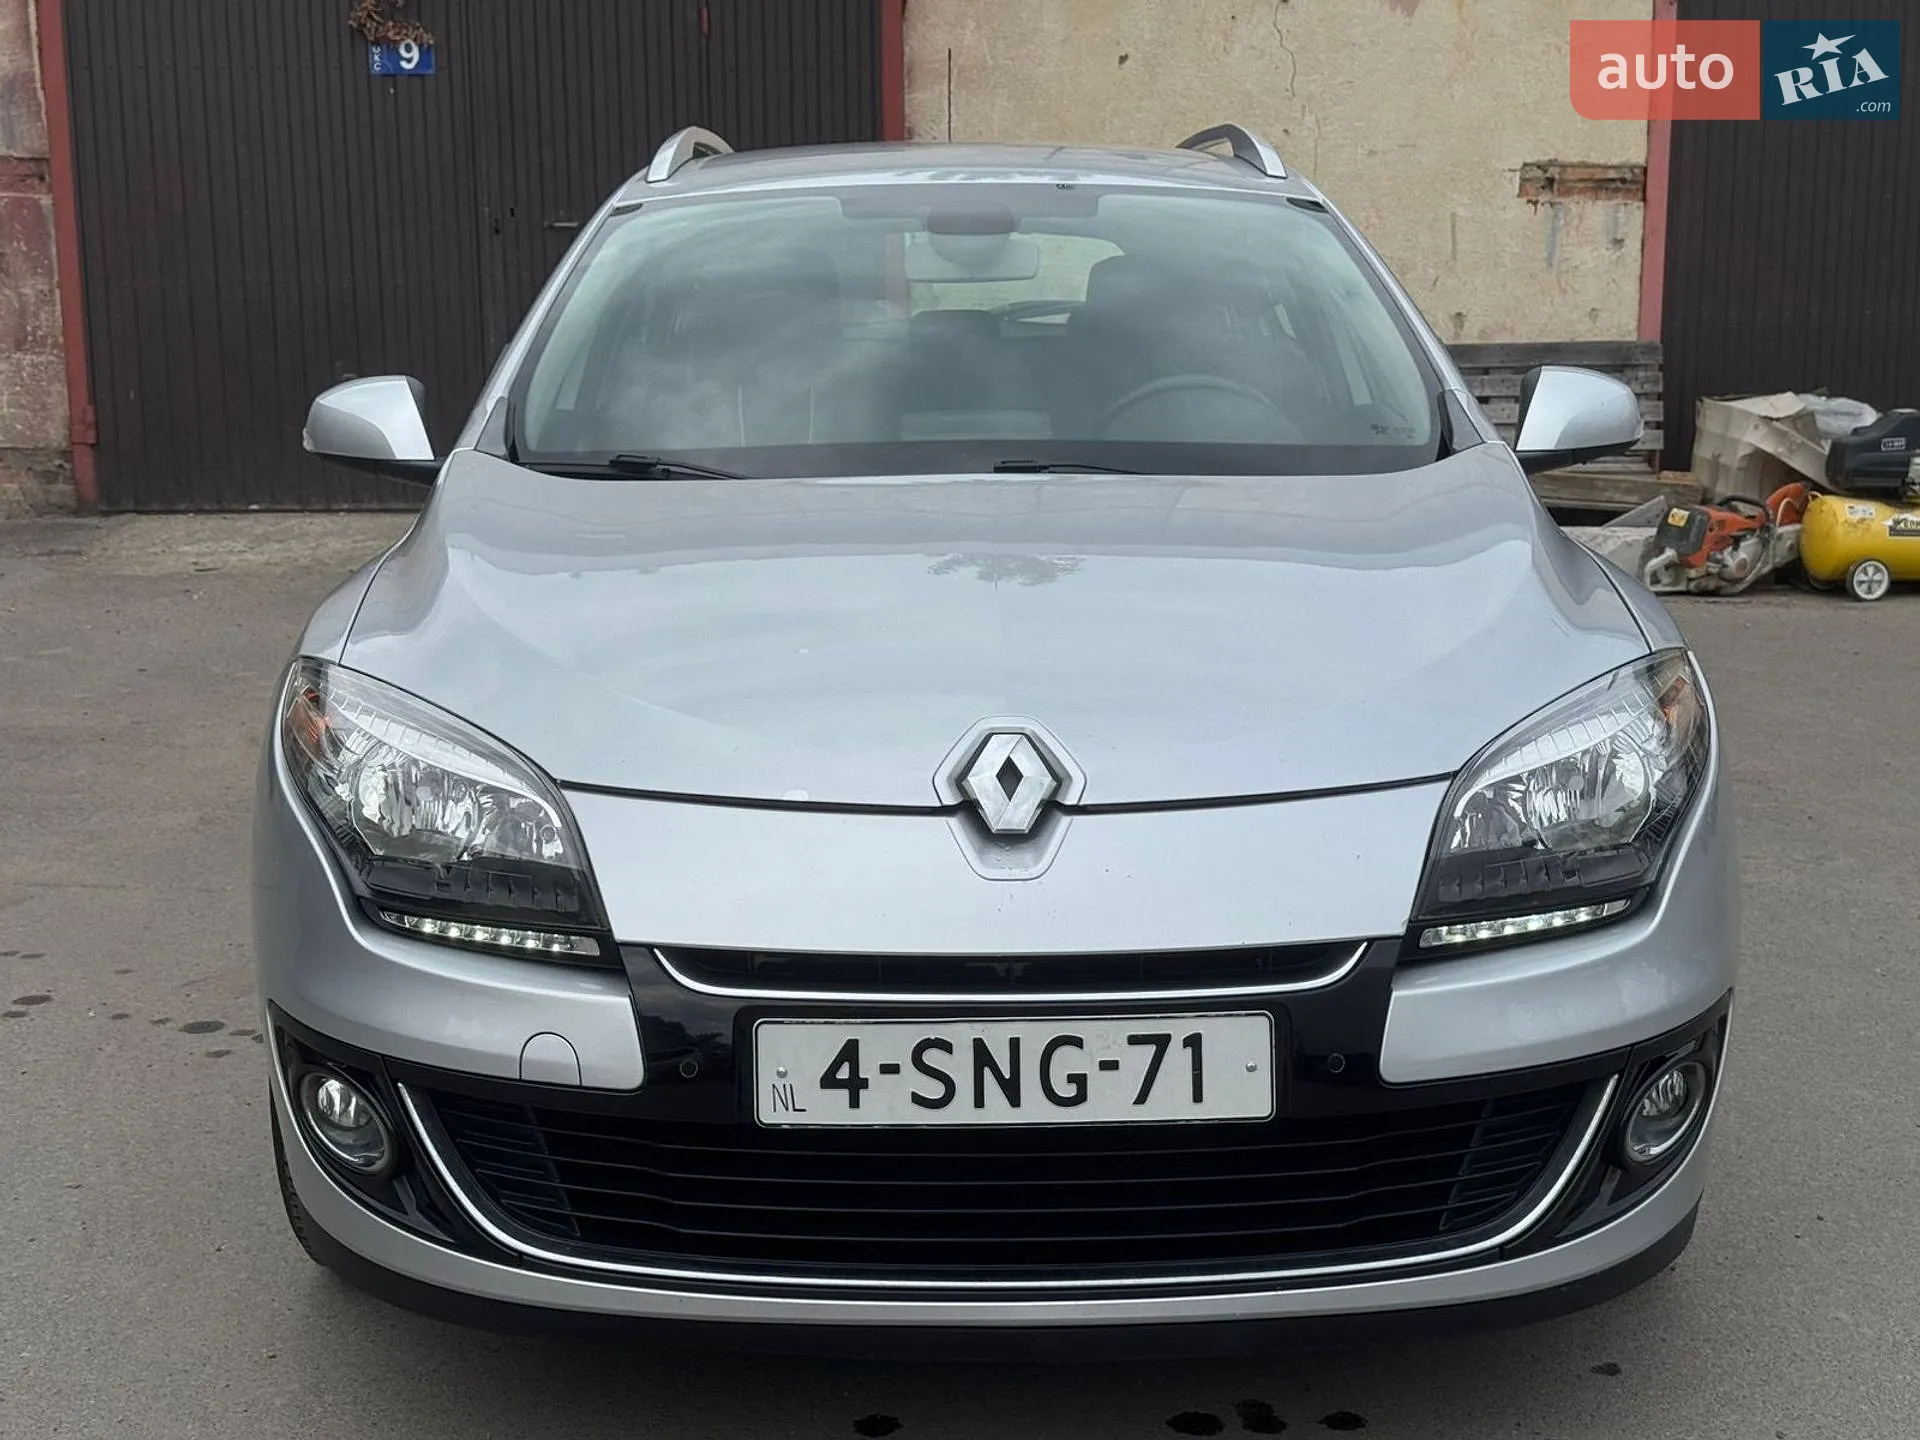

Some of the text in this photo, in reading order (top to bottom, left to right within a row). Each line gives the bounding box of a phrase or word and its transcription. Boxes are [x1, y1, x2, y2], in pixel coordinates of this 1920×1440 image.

[399, 39, 420, 70] 9
[819, 1032, 1204, 1110] 4-SNG-71
[771, 1083, 807, 1113] NL
